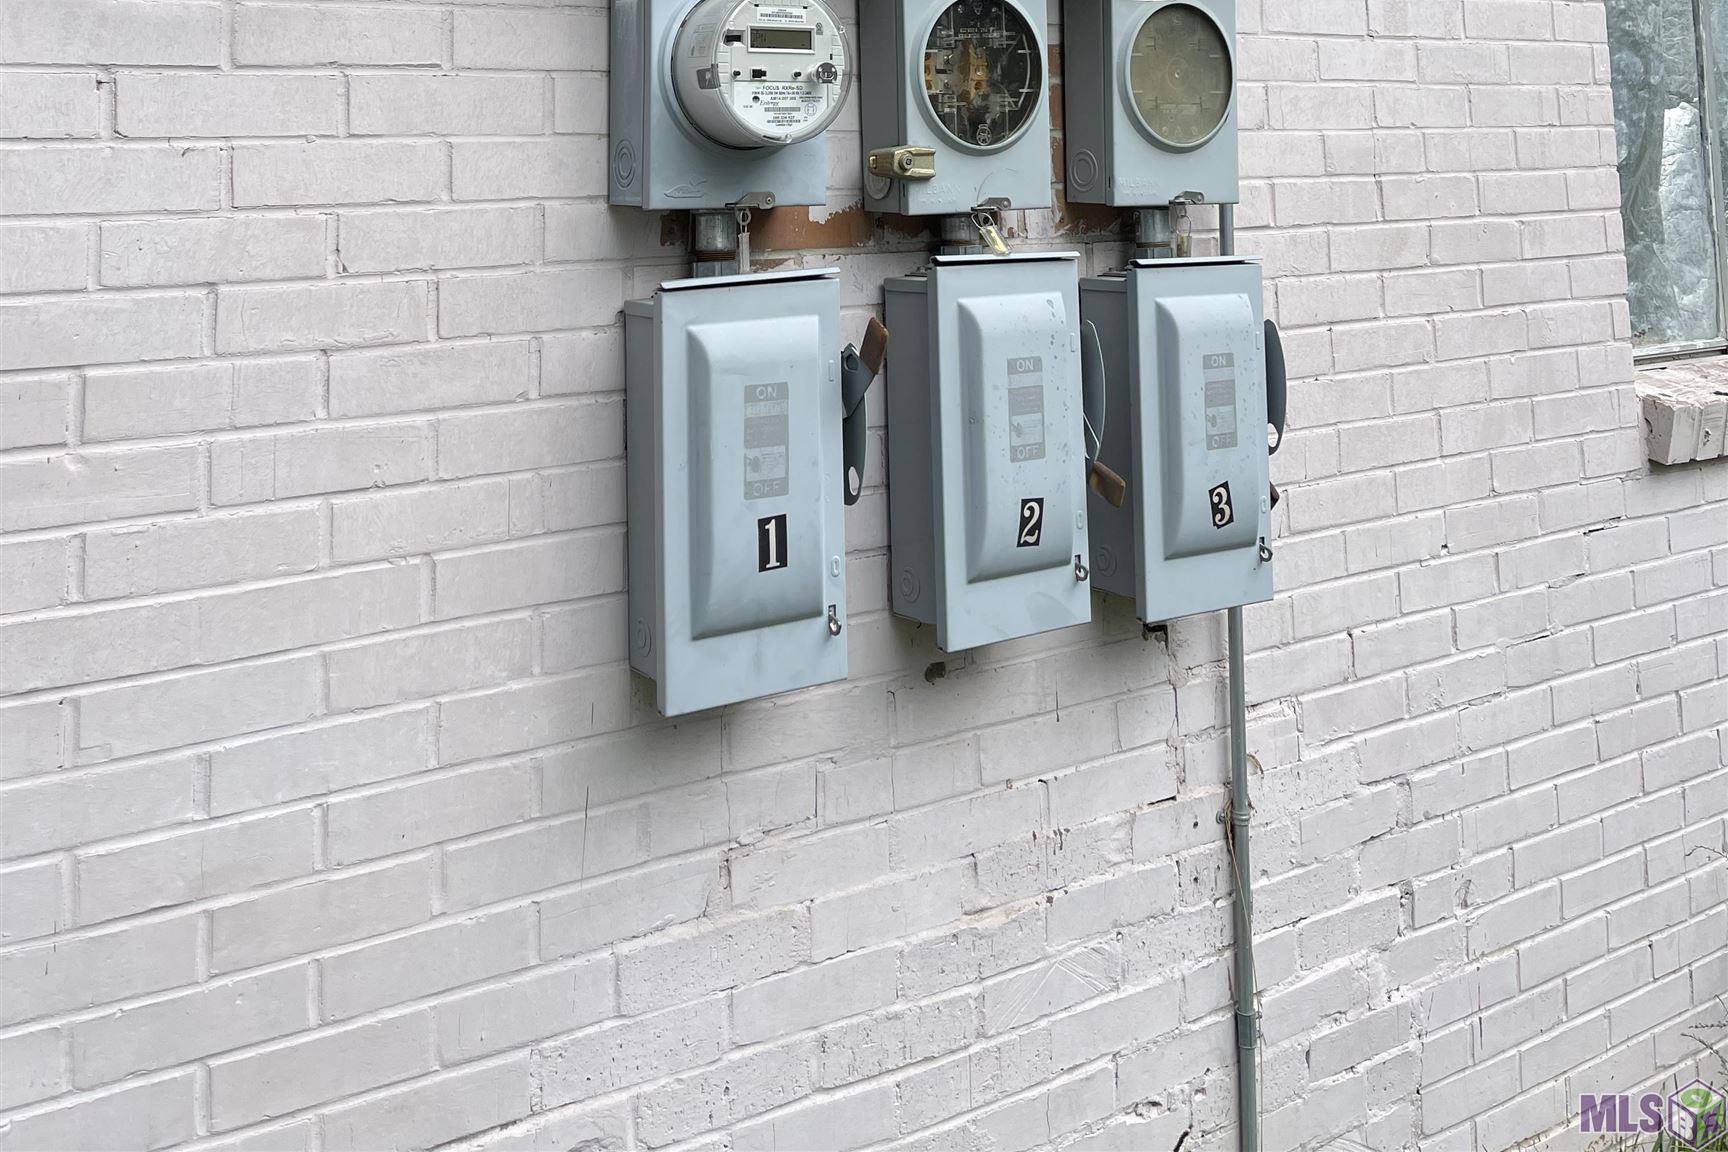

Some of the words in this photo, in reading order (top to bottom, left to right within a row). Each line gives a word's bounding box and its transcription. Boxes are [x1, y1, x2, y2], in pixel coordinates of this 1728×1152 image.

[1016, 359, 1034, 371] ON
[1211, 355, 1226, 367] ON
[756, 386, 777, 400] ON
[1212, 433, 1232, 448] OFF
[1017, 446, 1039, 459] OFF
[753, 480, 780, 496] OFF
[1212, 486, 1231, 526] 3
[1020, 501, 1040, 544] 2
[765, 518, 781, 568] 1
